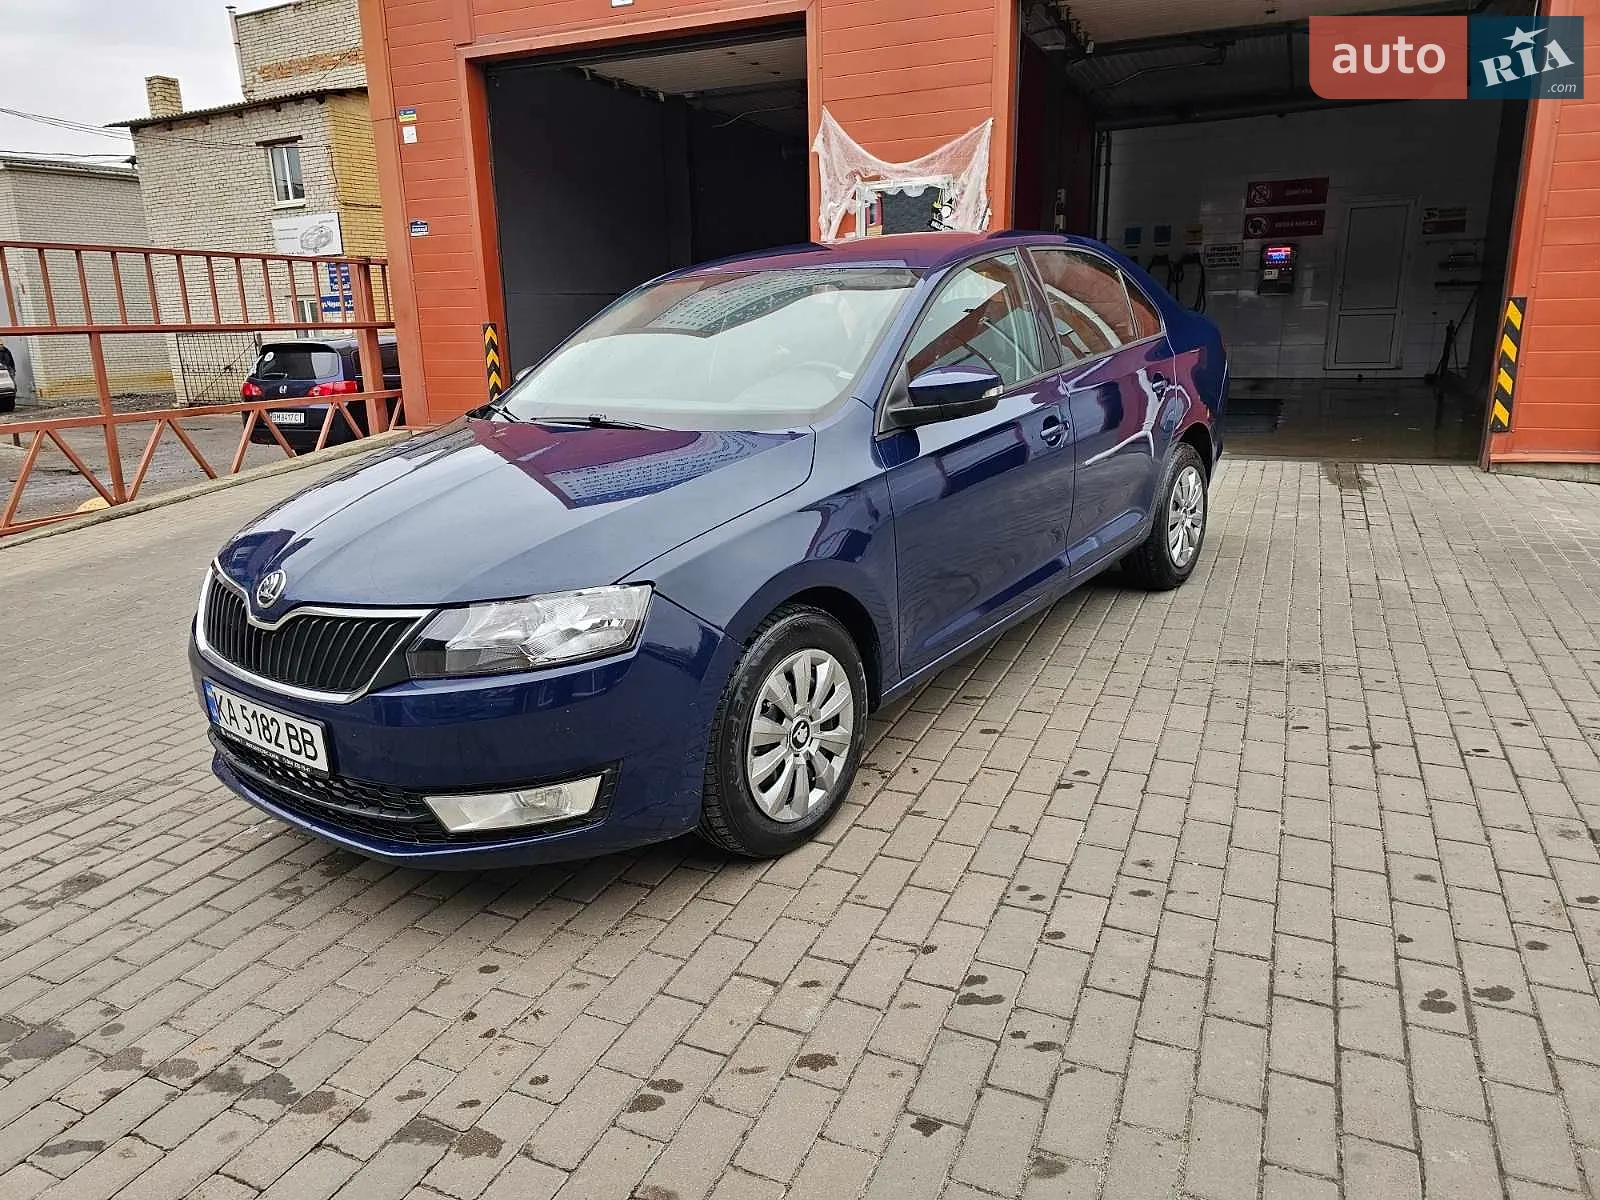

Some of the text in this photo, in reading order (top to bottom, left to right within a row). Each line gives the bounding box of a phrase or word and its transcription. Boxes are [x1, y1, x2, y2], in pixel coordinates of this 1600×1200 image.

[212, 691, 240, 730] KA
[240, 704, 285, 750] 5182
[285, 722, 318, 761] BB
